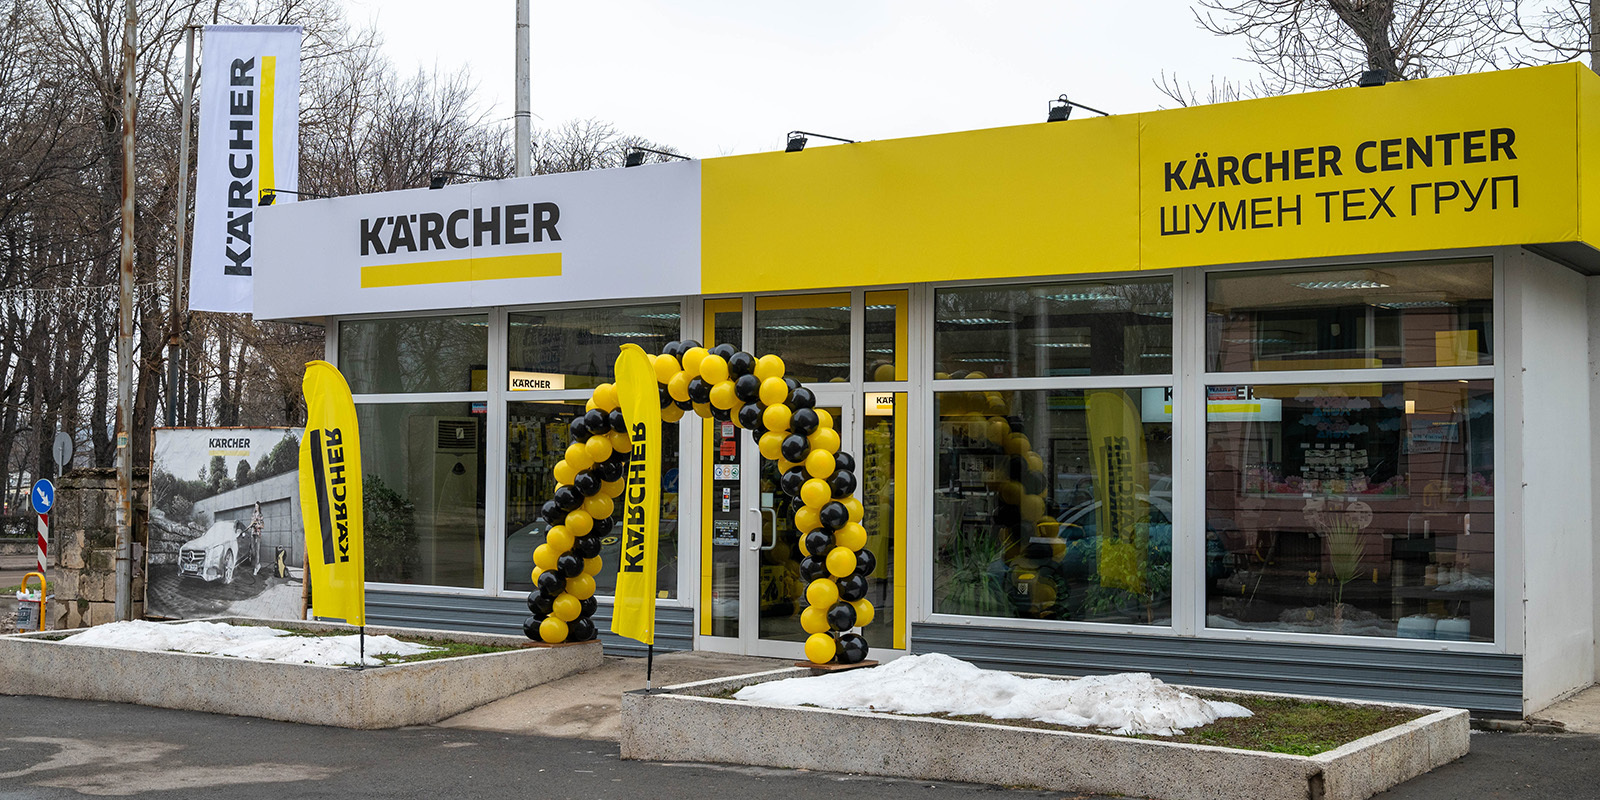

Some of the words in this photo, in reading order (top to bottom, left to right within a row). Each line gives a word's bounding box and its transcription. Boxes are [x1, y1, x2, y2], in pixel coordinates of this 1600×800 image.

[224, 56, 256, 276] KÄRCHER
[1164, 145, 1342, 192] KÄRCHER
[1355, 127, 1518, 174] CENTER
[360, 202, 562, 256] KÄRCHER
[1160, 194, 1302, 236] ШУМЕН
[1315, 185, 1396, 223] ТЕХ
[1410, 175, 1519, 217] ГРУП
[209, 438, 250, 449] KÄRCHER
